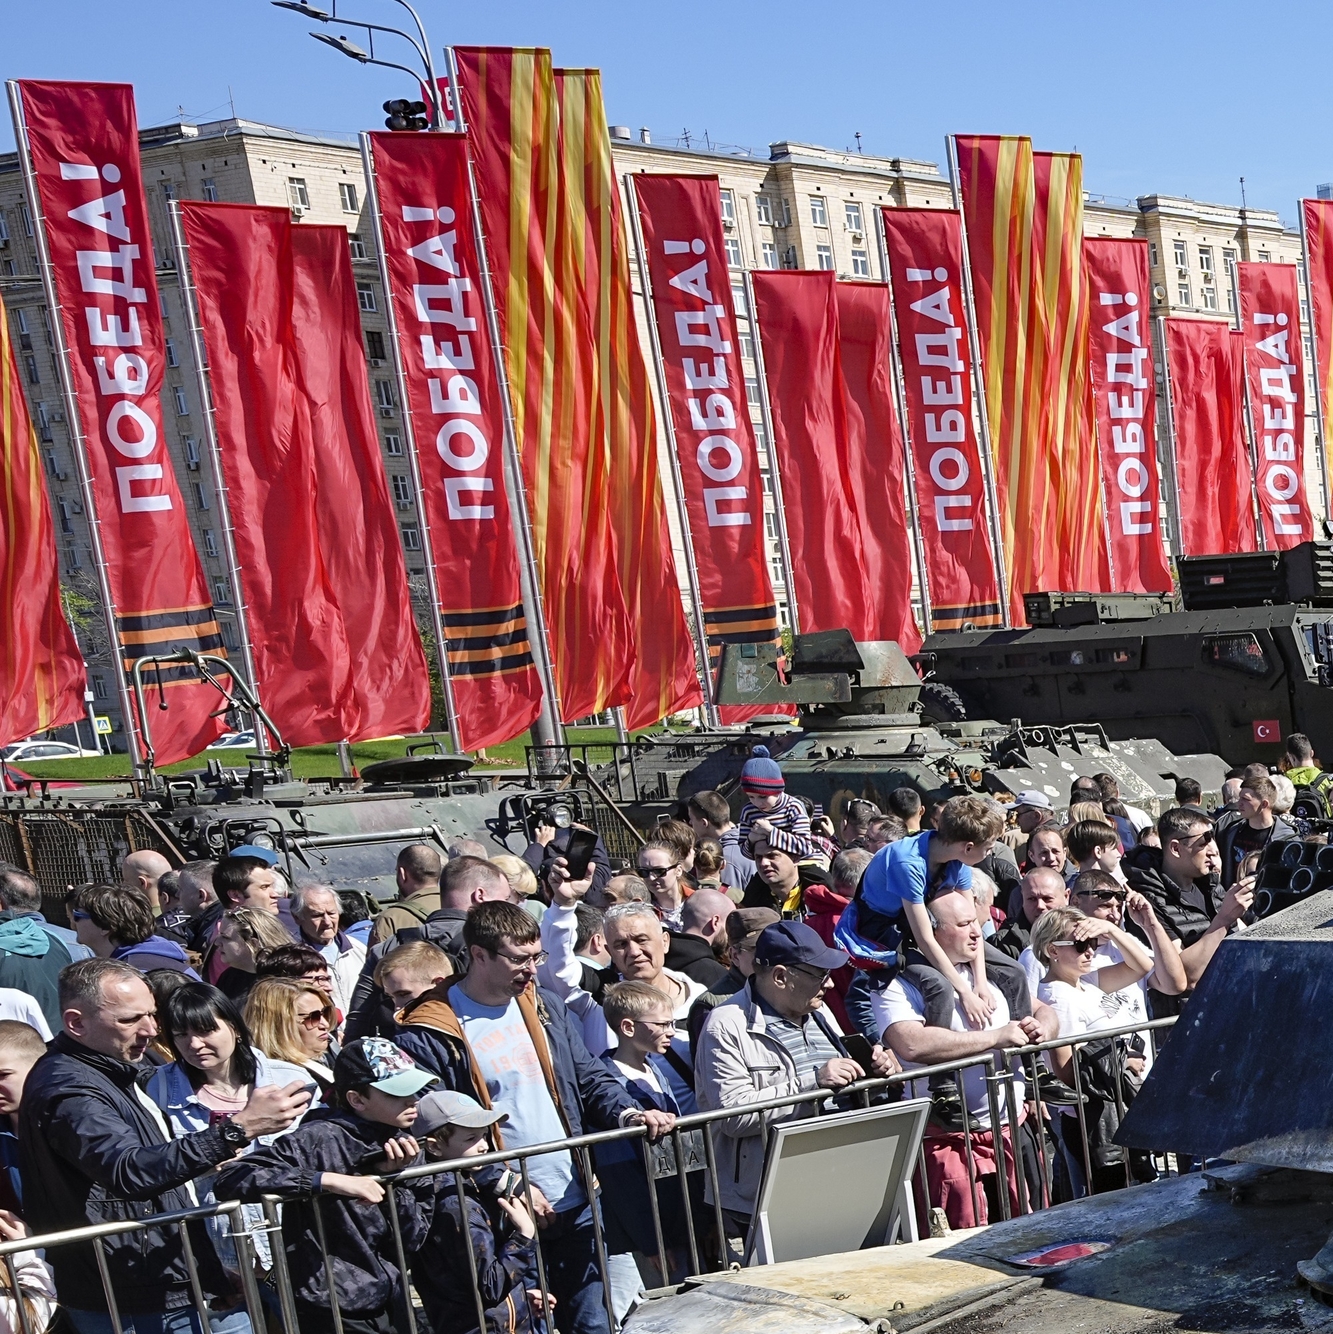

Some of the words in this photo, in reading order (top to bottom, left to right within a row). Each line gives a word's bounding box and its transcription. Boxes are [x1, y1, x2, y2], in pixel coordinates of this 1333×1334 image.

[58, 161, 173, 514] ПОБЕДА!
[402, 204, 493, 521] ПОБЕДА!
[663, 237, 751, 527] ПОБЕДА!
[905, 266, 973, 532] ПОБЕДА!
[1099, 291, 1152, 536] ПОБЕДА!
[1253, 311, 1303, 535] ПОБЕДА!
